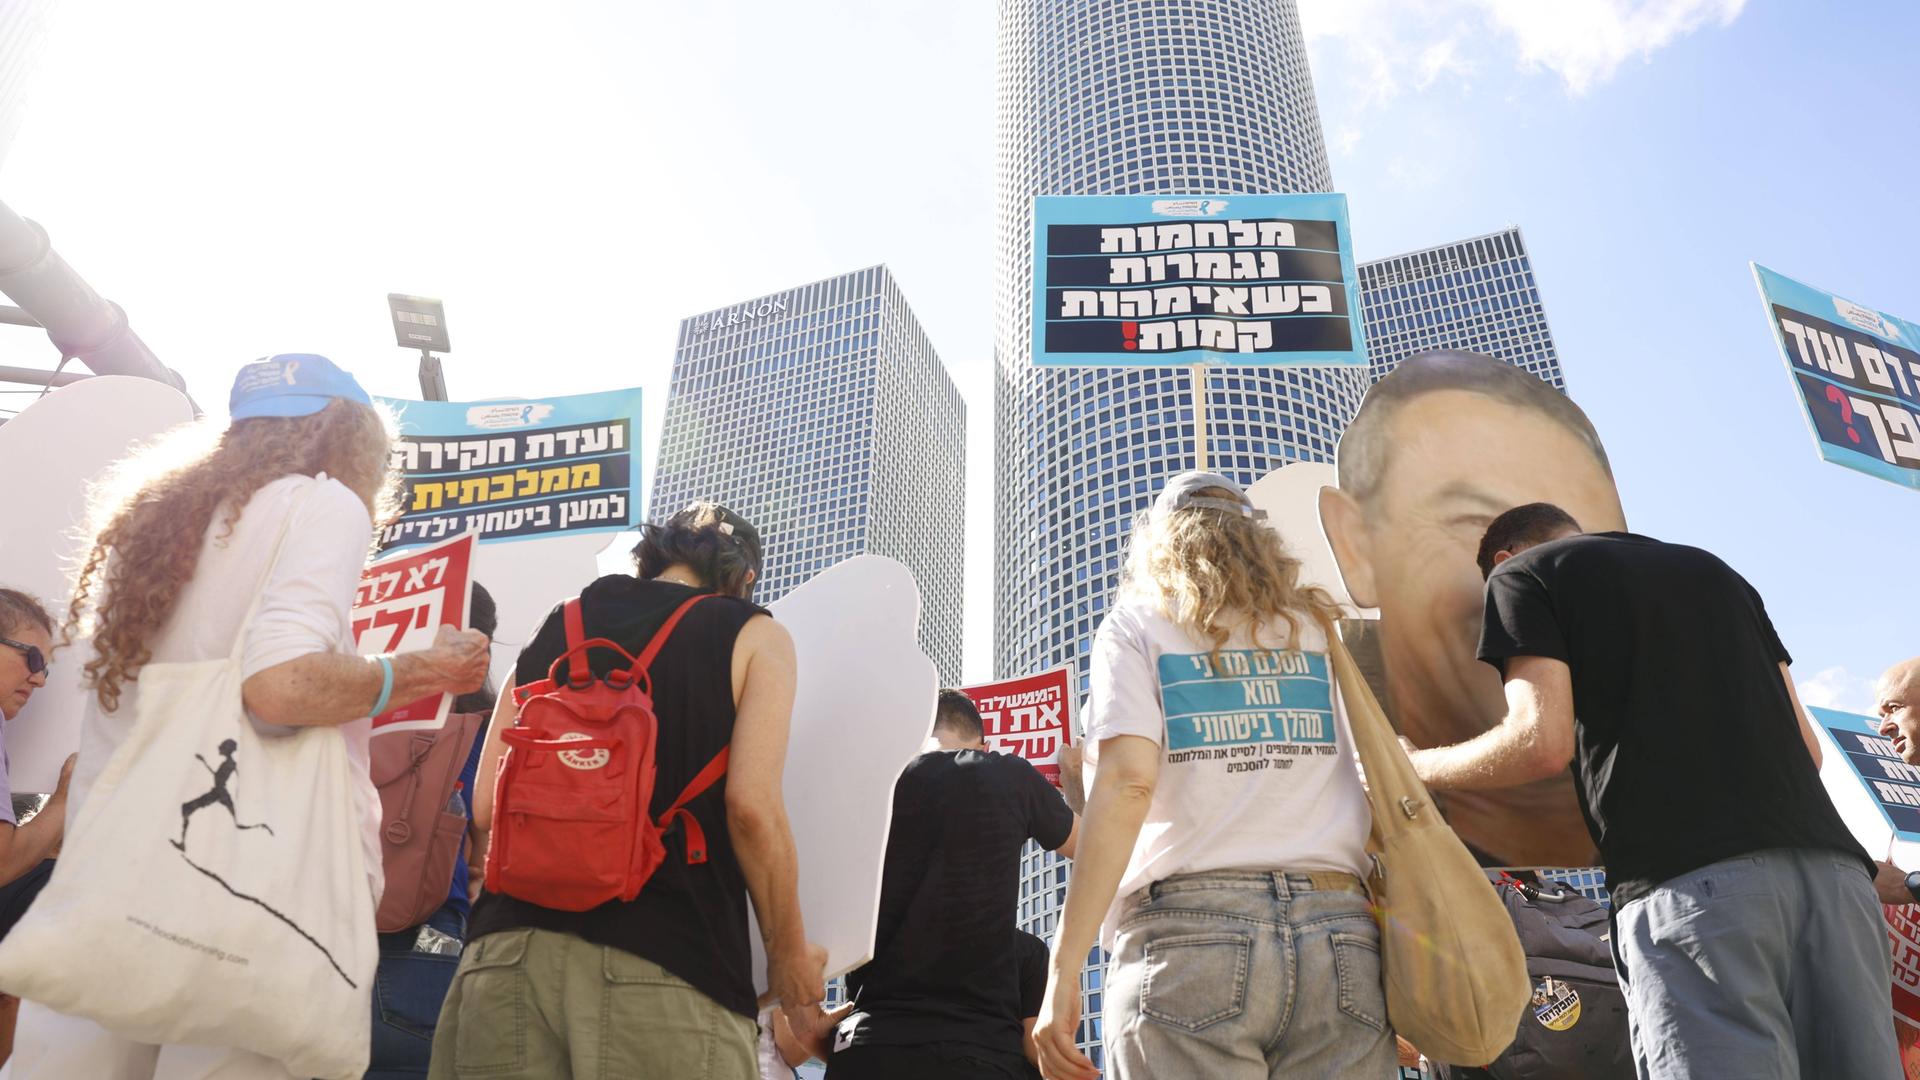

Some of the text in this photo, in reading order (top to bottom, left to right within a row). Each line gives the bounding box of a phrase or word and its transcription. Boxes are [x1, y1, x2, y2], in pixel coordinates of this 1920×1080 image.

[1101, 220, 1296, 253] מלחמות
[1109, 251, 1280, 284] נגמרות
[711, 298, 789, 331] ARNON
[1061, 285, 1333, 318] כשאימהות
[1122, 319, 1274, 353] קמות!
[1781, 318, 1856, 380] עוד
[391, 424, 624, 471] ועדת חקירה
[411, 463, 601, 511] ממלכתית
[382, 494, 626, 543] למען ביטחון ילדינו
[404, 556, 449, 592] לא
[1190, 650, 1310, 678] הסכם מדני
[980, 685, 1061, 711] הממשלה
[1242, 679, 1281, 706] הוא
[1010, 700, 1062, 732] את
[1192, 709, 1323, 745] מהלך ביטחוני
[1168, 750, 1212, 764] המלחמה
[1214, 748, 1228, 760] את
[1227, 758, 1270, 774] להסכמים
[1230, 744, 1256, 757] לסיים
